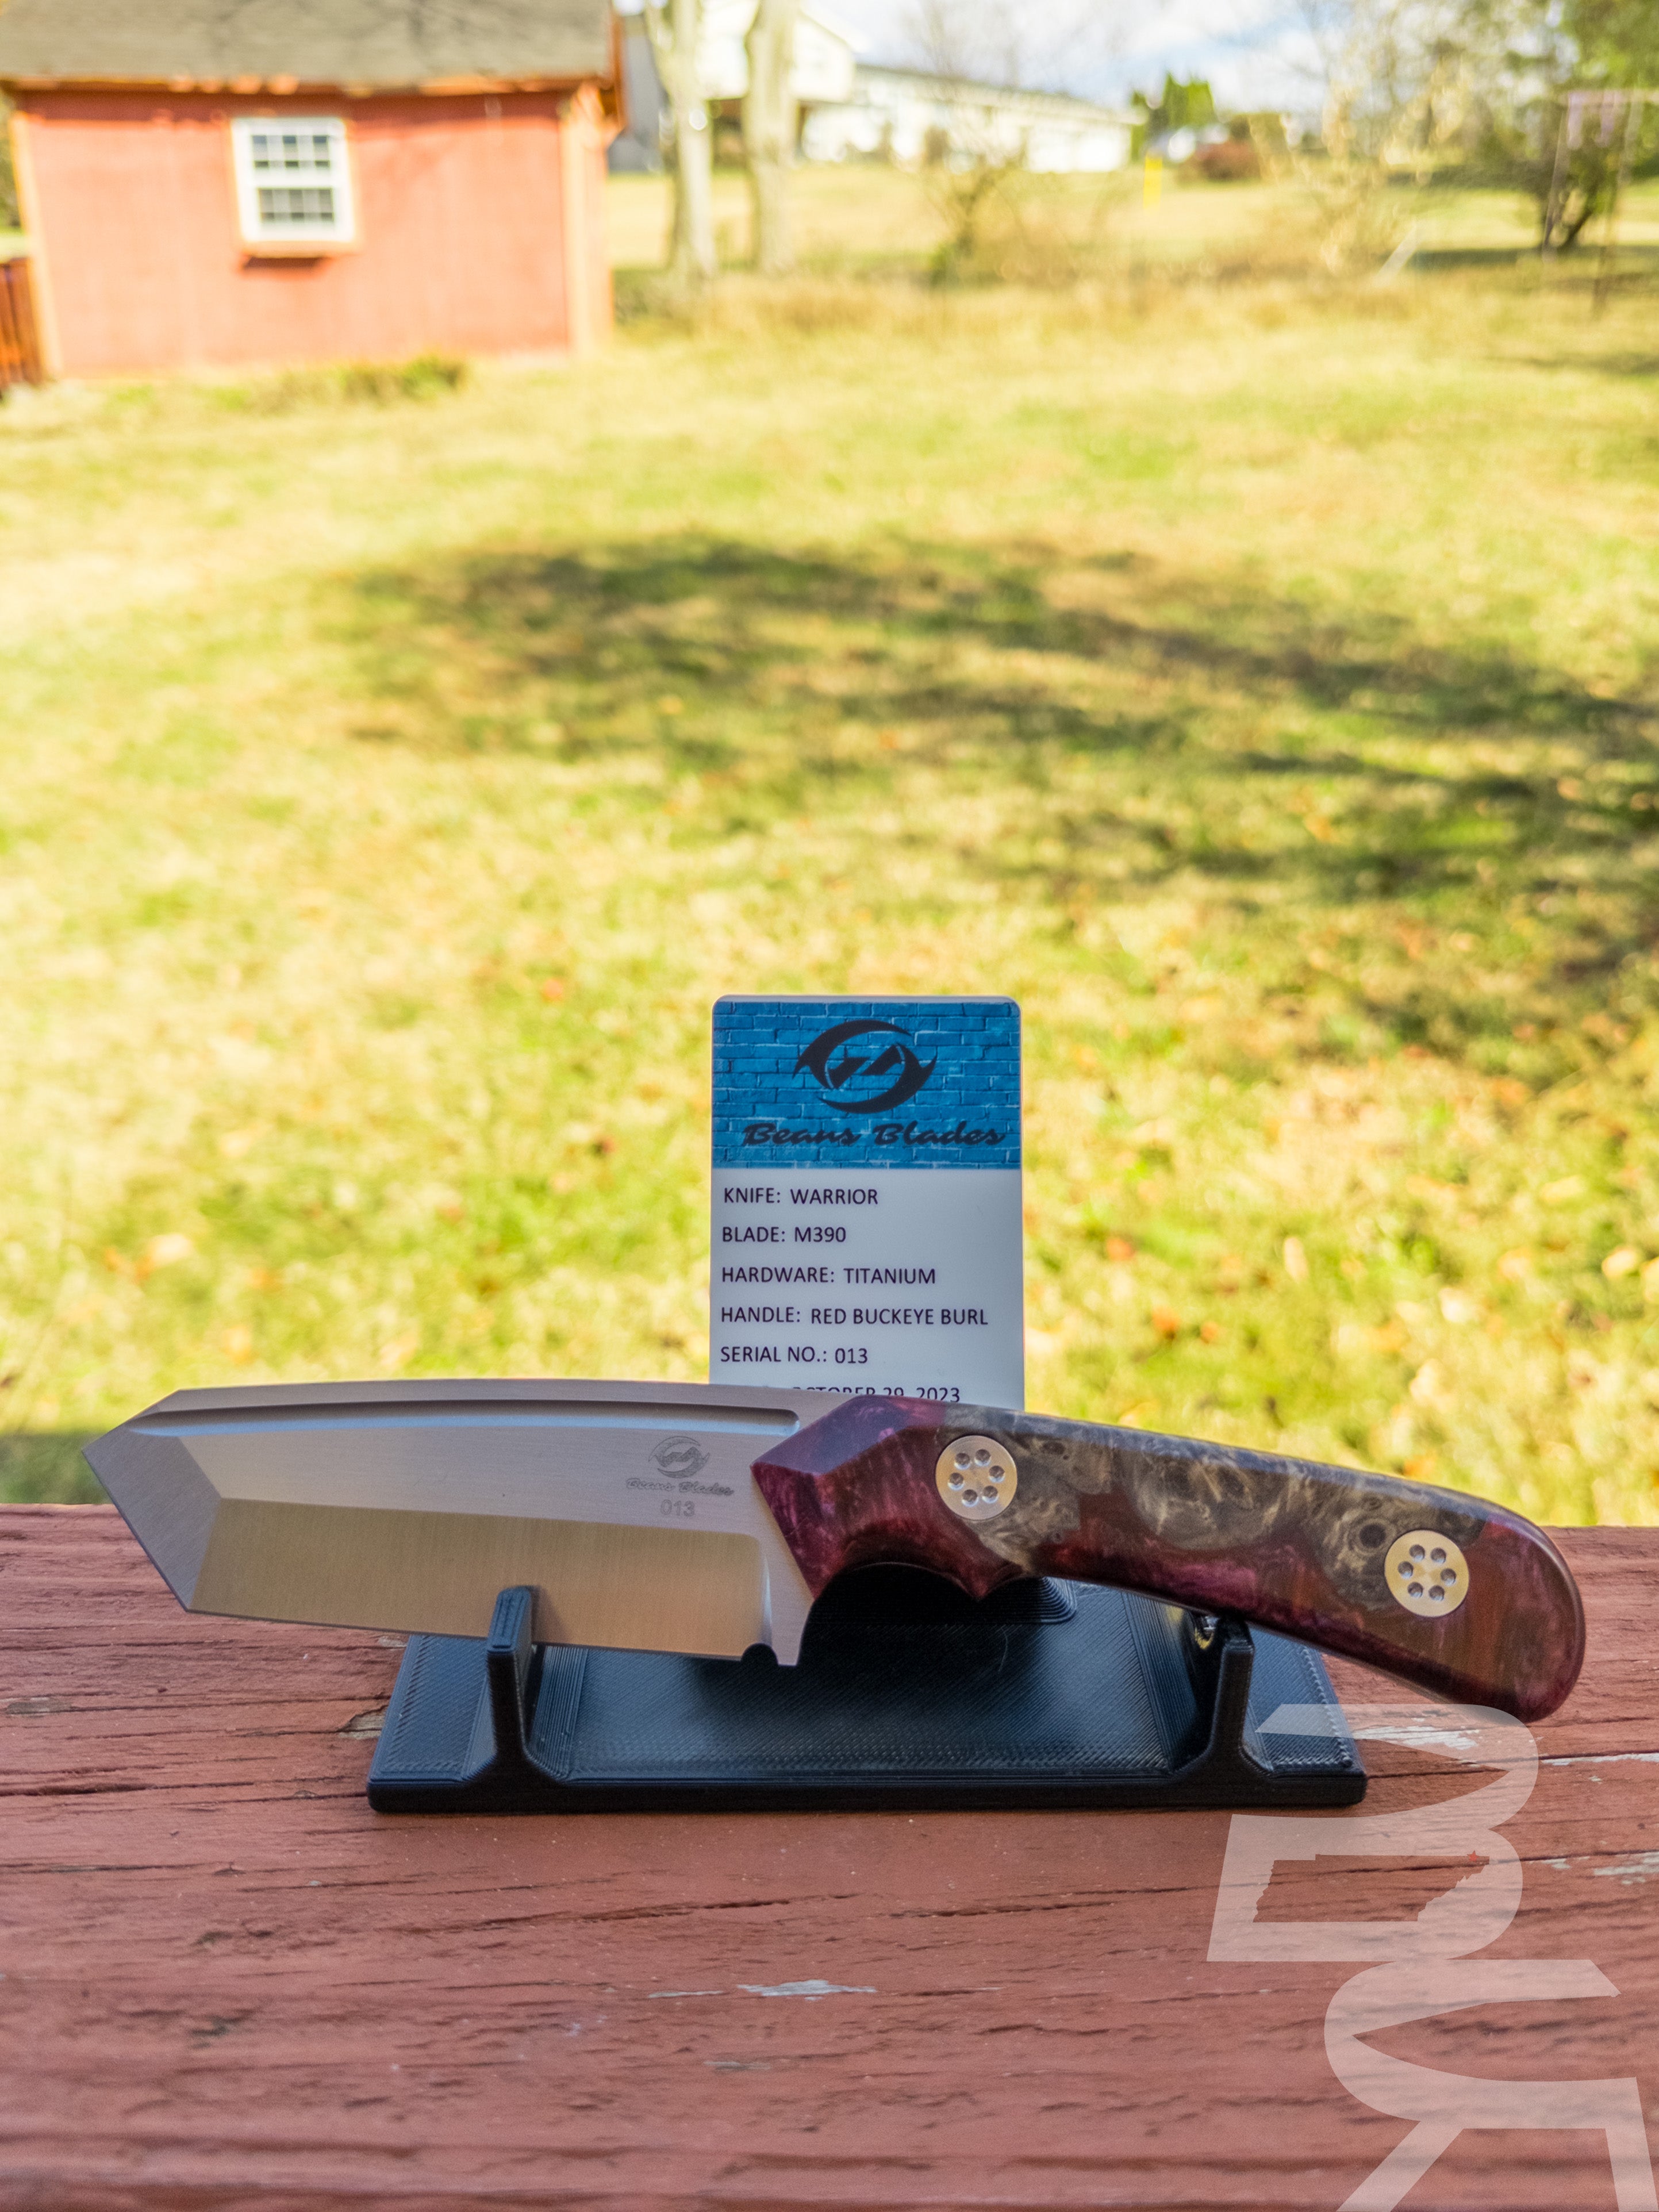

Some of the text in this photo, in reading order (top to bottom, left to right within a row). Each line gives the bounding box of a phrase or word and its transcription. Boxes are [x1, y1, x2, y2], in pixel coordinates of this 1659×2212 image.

[743, 1120, 1006, 1146] Beans Blades
[724, 1187, 878, 1205] KNIFE: WARRIOR
[722, 1226, 847, 1243] BLADE: M390
[722, 1266, 936, 1284] HARDWARE: TITANIUM
[721, 1306, 989, 1326] HANDLE: RED BUCKEYE BURL
[720, 1346, 868, 1364] SERIAL NO.: 013
[916, 1387, 960, 1403] 2023
[625, 1477, 735, 1496] Beans Blades
[661, 1499, 695, 1517] 013
